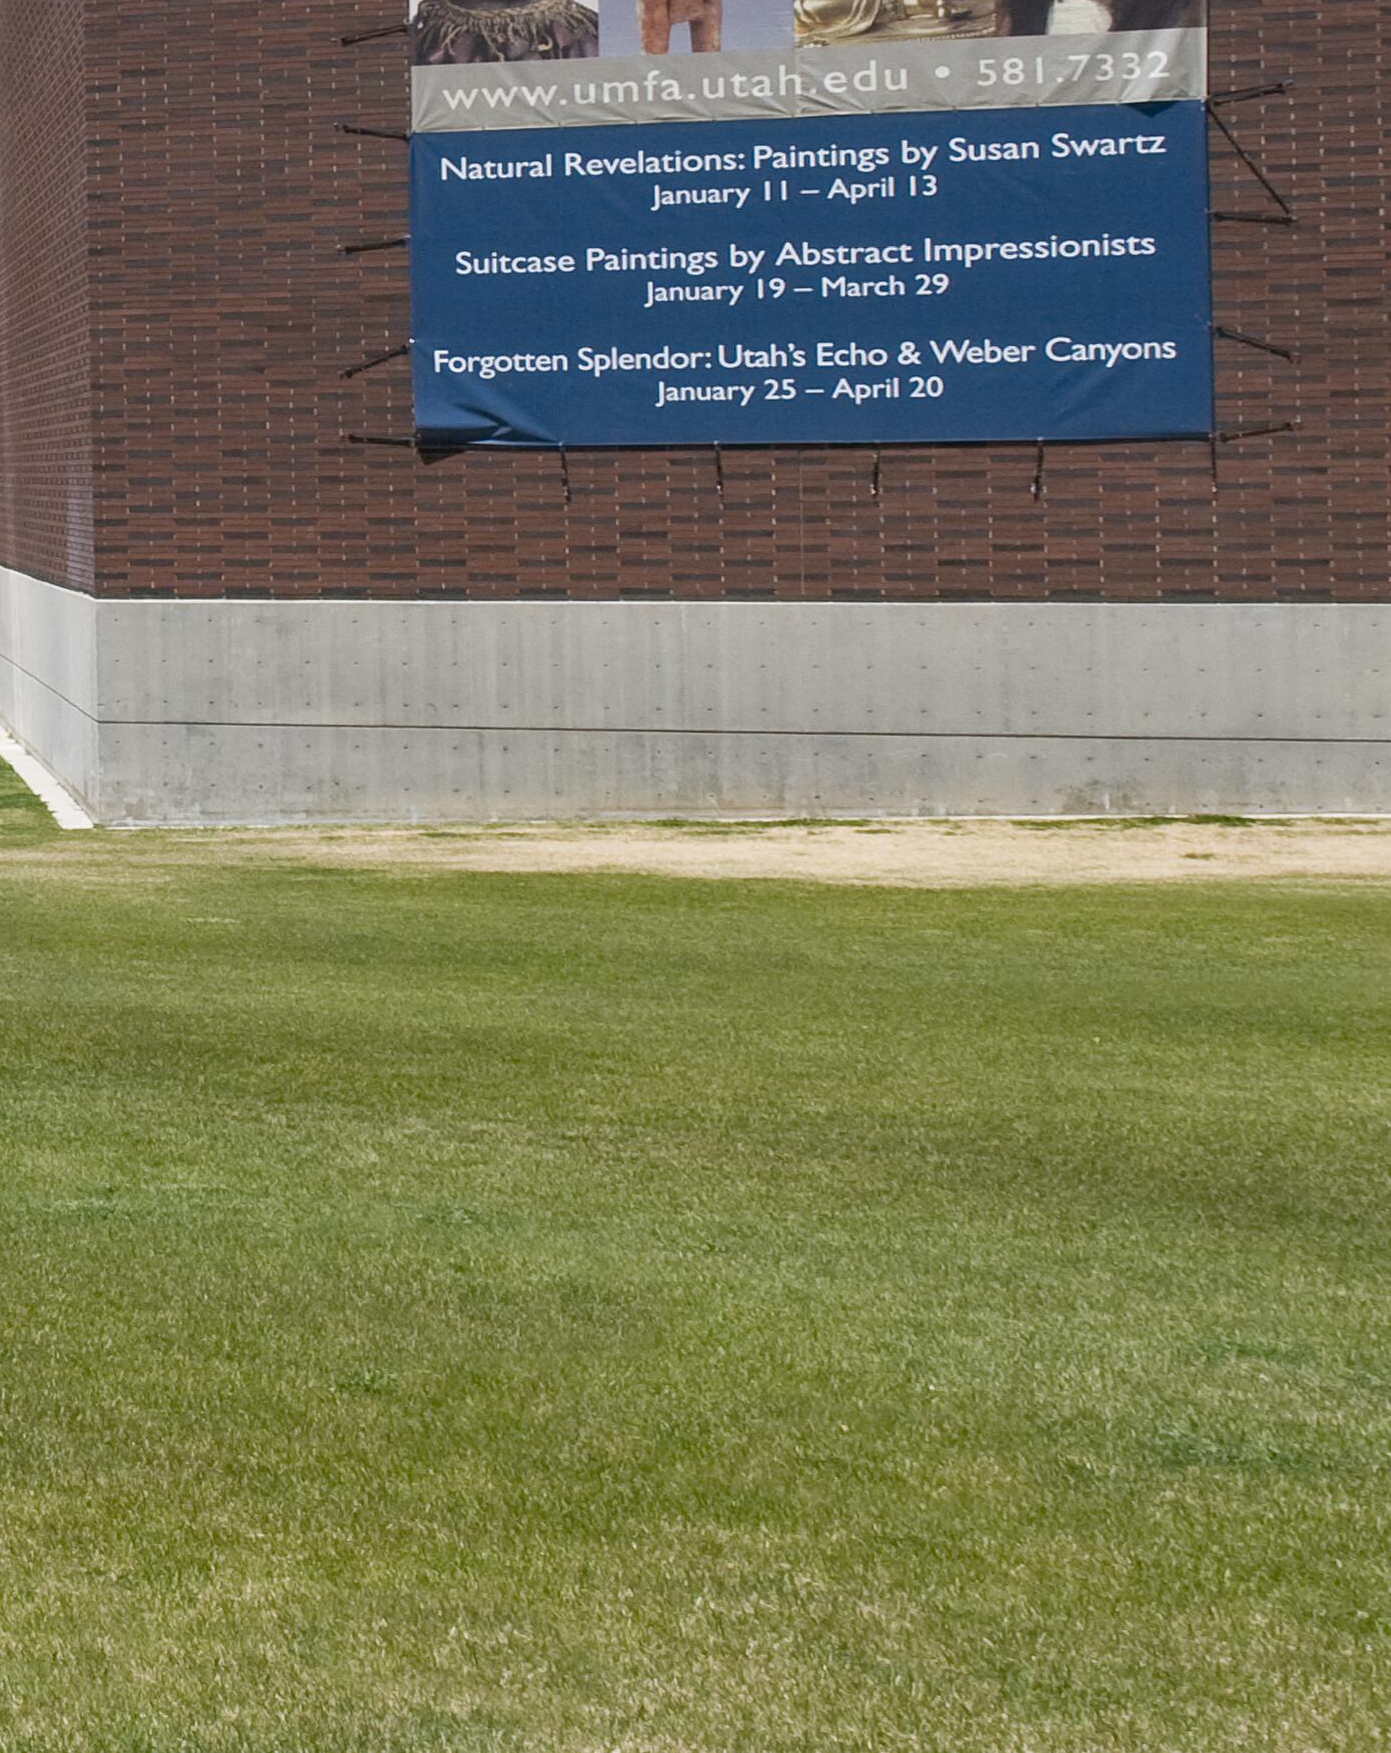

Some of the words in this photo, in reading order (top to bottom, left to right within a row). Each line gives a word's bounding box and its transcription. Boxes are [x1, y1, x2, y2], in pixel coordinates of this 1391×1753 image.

[442, 60, 908, 110] www.umfa.utah.edu
[977, 51, 1170, 87] 581.7332
[441, 153, 552, 181] Natural
[564, 150, 746, 176] Revelations:
[753, 143, 890, 173] Paintings
[901, 139, 939, 171] by
[949, 137, 1040, 162] Susan
[1051, 132, 1167, 158] Swartz
[650, 184, 751, 212] January
[764, 179, 788, 202] 11
[827, 176, 895, 205] April
[909, 174, 938, 197] 13
[455, 251, 576, 275] Suitcase
[586, 247, 719, 276] Paintings
[729, 243, 766, 275] by
[775, 241, 914, 266] Abstract
[924, 233, 1156, 268] Impressionists
[643, 281, 744, 308] January
[757, 277, 786, 299] 19
[821, 274, 906, 298] March
[915, 273, 950, 295] 29
[433, 349, 569, 380] Forgotten
[577, 345, 712, 378] Splendor:
[816, 341, 889, 367] Echo
[897, 341, 922, 366] &
[929, 338, 1036, 364] Weber
[1045, 336, 1177, 368] Canyons
[655, 381, 756, 408] January
[763, 378, 797, 400] 25
[832, 377, 900, 405] April
[909, 375, 944, 398] 20
